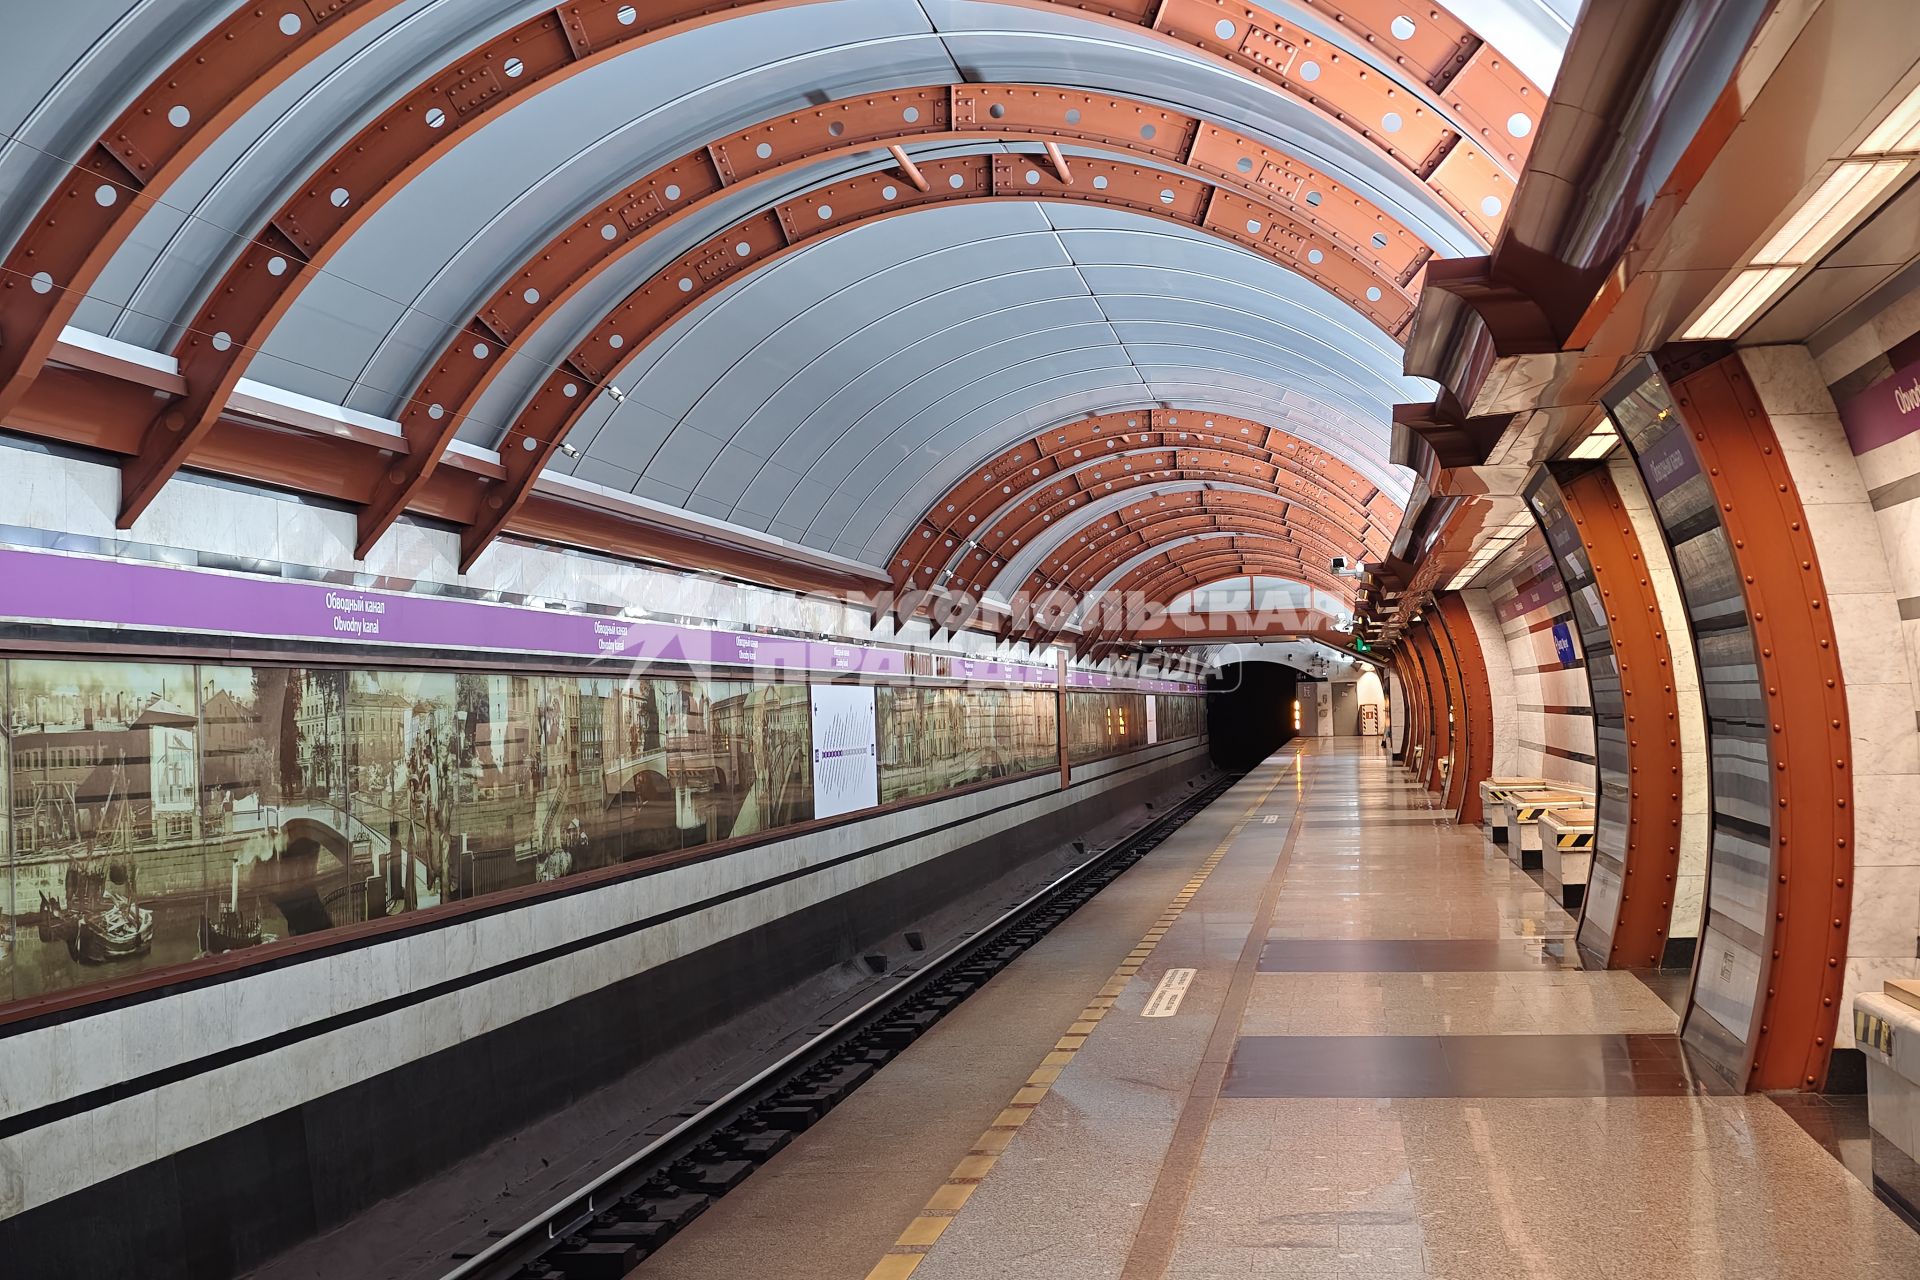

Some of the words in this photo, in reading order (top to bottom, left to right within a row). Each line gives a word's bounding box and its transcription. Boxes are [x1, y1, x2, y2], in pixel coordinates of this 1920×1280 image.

[325, 592, 364, 613] Обводный
[364, 600, 385, 614] канал
[333, 615, 363, 636] Obvodny
[362, 617, 380, 634] kanal
